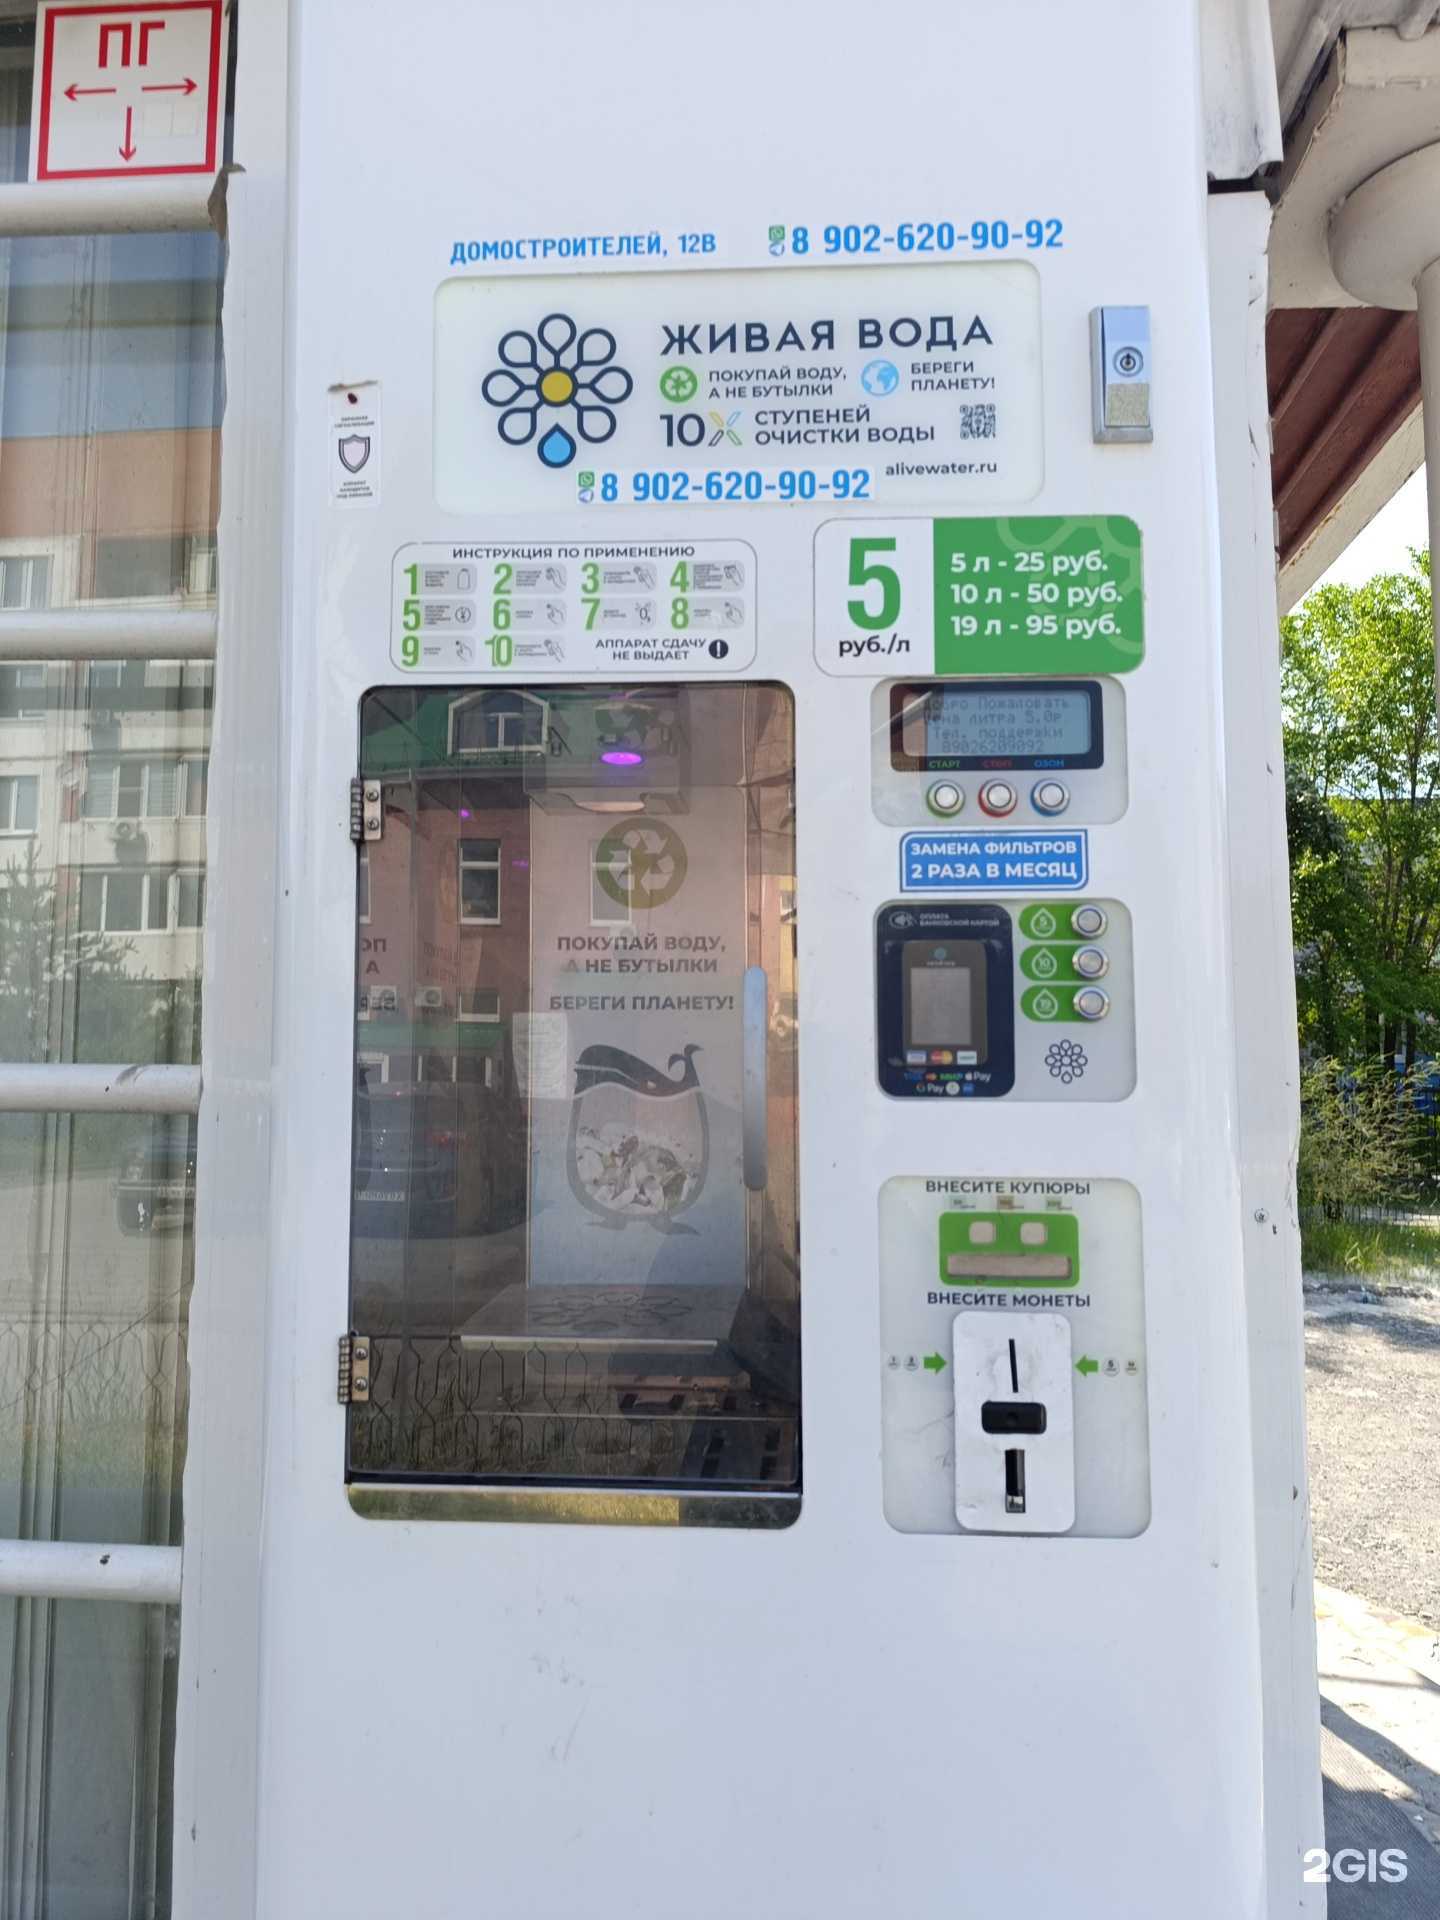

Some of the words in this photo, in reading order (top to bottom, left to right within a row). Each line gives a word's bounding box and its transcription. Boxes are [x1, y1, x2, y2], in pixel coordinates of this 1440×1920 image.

[98, 20, 165, 68] ПГ
[450, 232, 668, 264] ДОМОСТРОИТЕЛЕЙ,
[678, 233, 716, 254] 12В
[792, 226, 810, 254] 8
[824, 219, 1064, 253] 902-620-90-92
[661, 320, 835, 356] ЖИВАЯ
[858, 315, 995, 352] ВОДА
[708, 363, 791, 382] ПОКУПАЙ
[796, 364, 847, 382] ВОДУ,
[911, 361, 975, 375] БЕРЕГИ
[708, 386, 722, 399] А
[725, 385, 750, 399] НЕ
[753, 383, 833, 398] БУТЫЛКИ
[911, 376, 996, 392] ПЛАНЕТУ!
[755, 403, 871, 425] СТУПЕНЕЙ
[755, 427, 863, 445] ОЧИСТКИ
[867, 424, 935, 444] ВОДЫ
[885, 460, 997, 477] alivewater.ru
[601, 472, 618, 501] 8
[633, 469, 871, 501] 902-620-90-92
[452, 548, 553, 560] ИНСТРУКЦИЯ
[558, 547, 580, 559] ПО
[584, 546, 695, 558] ПРИМЕНЕНИЮ
[951, 553, 965, 573] 5
[972, 555, 990, 573] л
[1014, 552, 1045, 572] 25
[1052, 551, 1109, 576] руб.
[403, 563, 418, 595] 1
[493, 563, 513, 594] 2
[581, 563, 600, 594] 3
[670, 561, 689, 592] 4
[847, 537, 900, 630] 5
[951, 584, 978, 604] 10
[984, 586, 1002, 603] л
[1027, 583, 1059, 603] 50
[1067, 581, 1123, 608] руб.
[403, 600, 421, 631] 5
[493, 599, 511, 630] 6
[581, 598, 601, 630] 7
[671, 597, 689, 629] 8
[951, 615, 978, 636] 19
[984, 617, 1002, 635] л
[1026, 615, 1058, 635] 95
[1066, 613, 1121, 639] руб.
[402, 636, 419, 667] 9
[485, 635, 512, 667] 10
[595, 639, 658, 649] АППАРАТ
[661, 638, 706, 649] СДАЧУ
[613, 651, 630, 660] НЕ
[633, 650, 689, 661] ВЫДАЕТ
[839, 633, 910, 657] руб./л
[928, 760, 961, 768] СТАРТ
[1034, 759, 1064, 768] ОЗОН
[911, 842, 981, 855] ЗАМЕНА
[984, 840, 1077, 855] ФИЛЬТРОВ
[911, 864, 923, 878] 2
[928, 863, 981, 878] РАЗА
[987, 863, 999, 878] В
[1005, 862, 1077, 880] МЕСЯЦ
[557, 934, 661, 951] ПОКУПАЙ
[664, 936, 727, 953] ВОДУ,
[565, 959, 579, 973] А
[586, 959, 612, 973] НЕ
[618, 958, 718, 973] БУТЫЛКИ
[549, 995, 626, 1010] БЕРЕГИ
[631, 995, 735, 1011] ПЛАНЕТУ!
[926, 1180, 1005, 1194] ВНЕСИТЕ
[1010, 1181, 1091, 1195] КУПЮРЫ
[927, 1292, 1007, 1307] ВНЕСИТЕ
[1012, 1294, 1091, 1307] МОНЕТЫ
